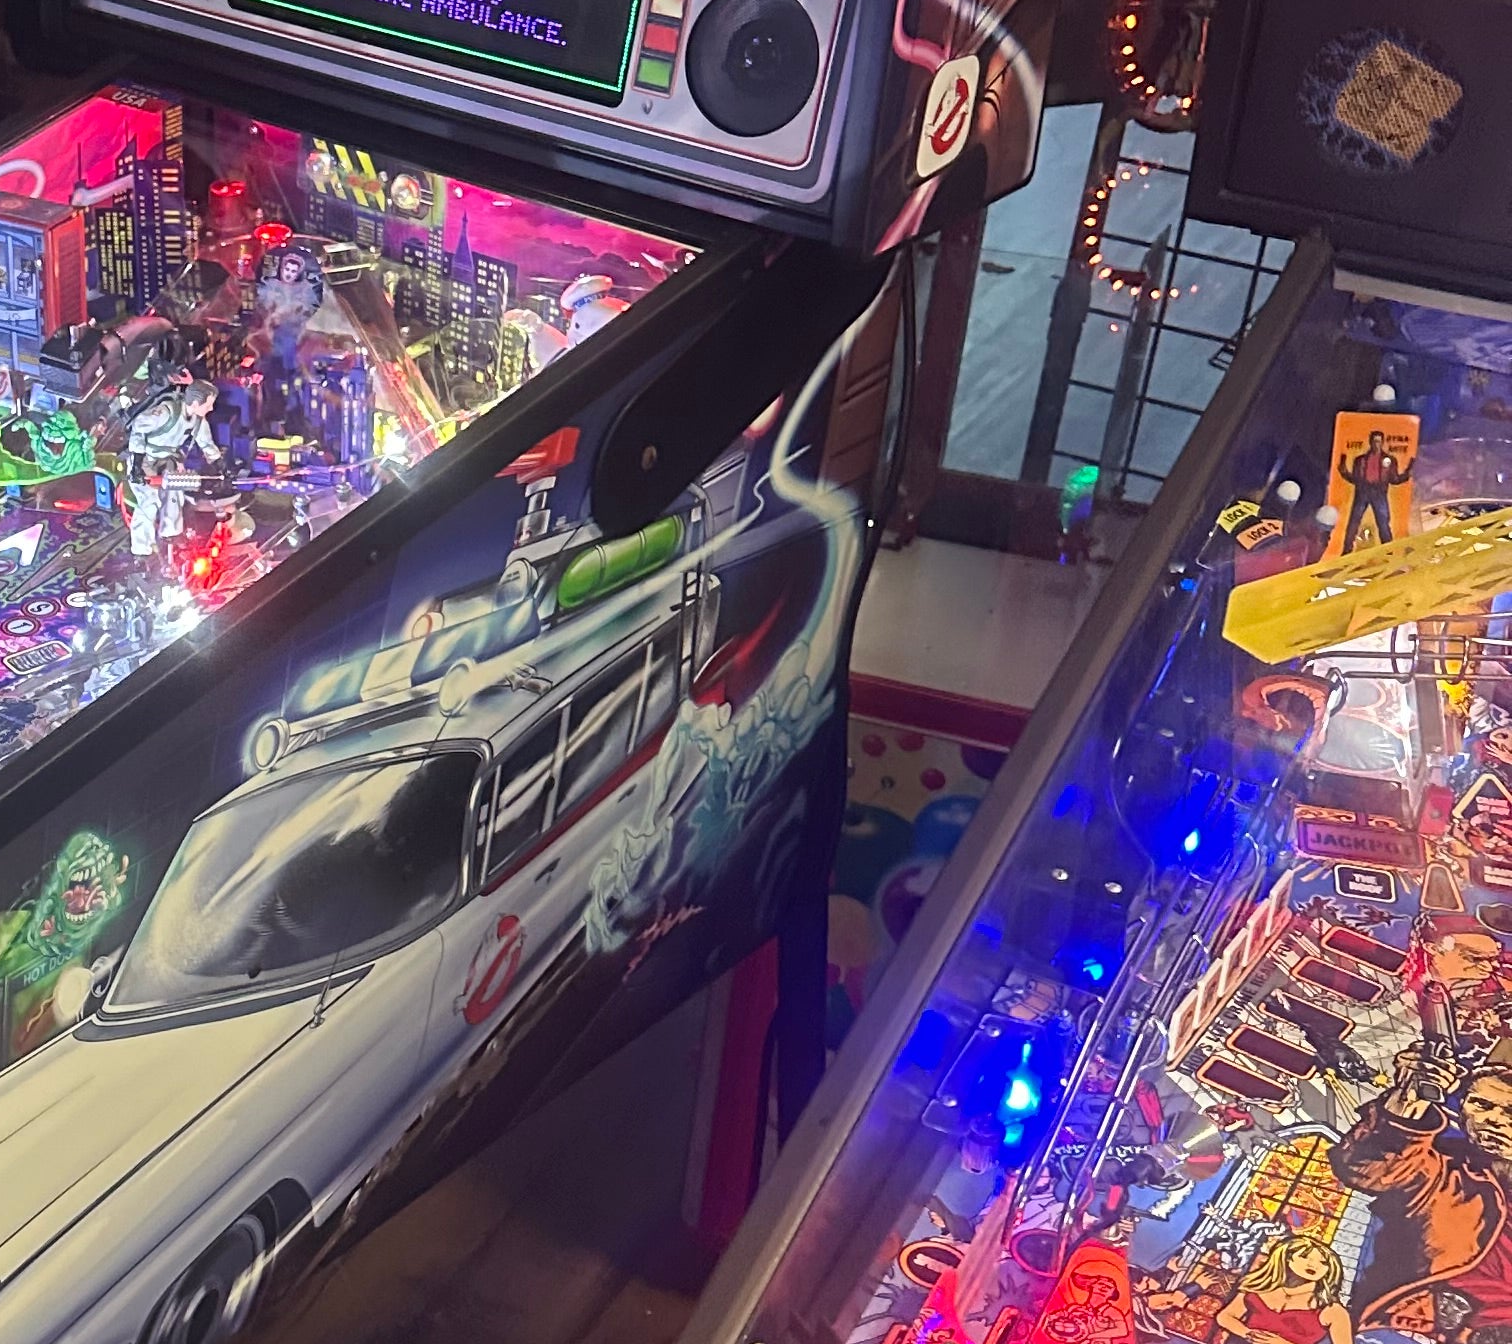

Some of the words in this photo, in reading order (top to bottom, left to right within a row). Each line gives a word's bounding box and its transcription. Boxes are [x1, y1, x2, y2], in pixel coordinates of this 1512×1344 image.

[111, 90, 148, 109] USA
[1224, 507, 1245, 525] LOCK
[1247, 526, 1268, 542] LOCK
[1270, 522, 1279, 533] 2
[23, 965, 45, 986] HOT
